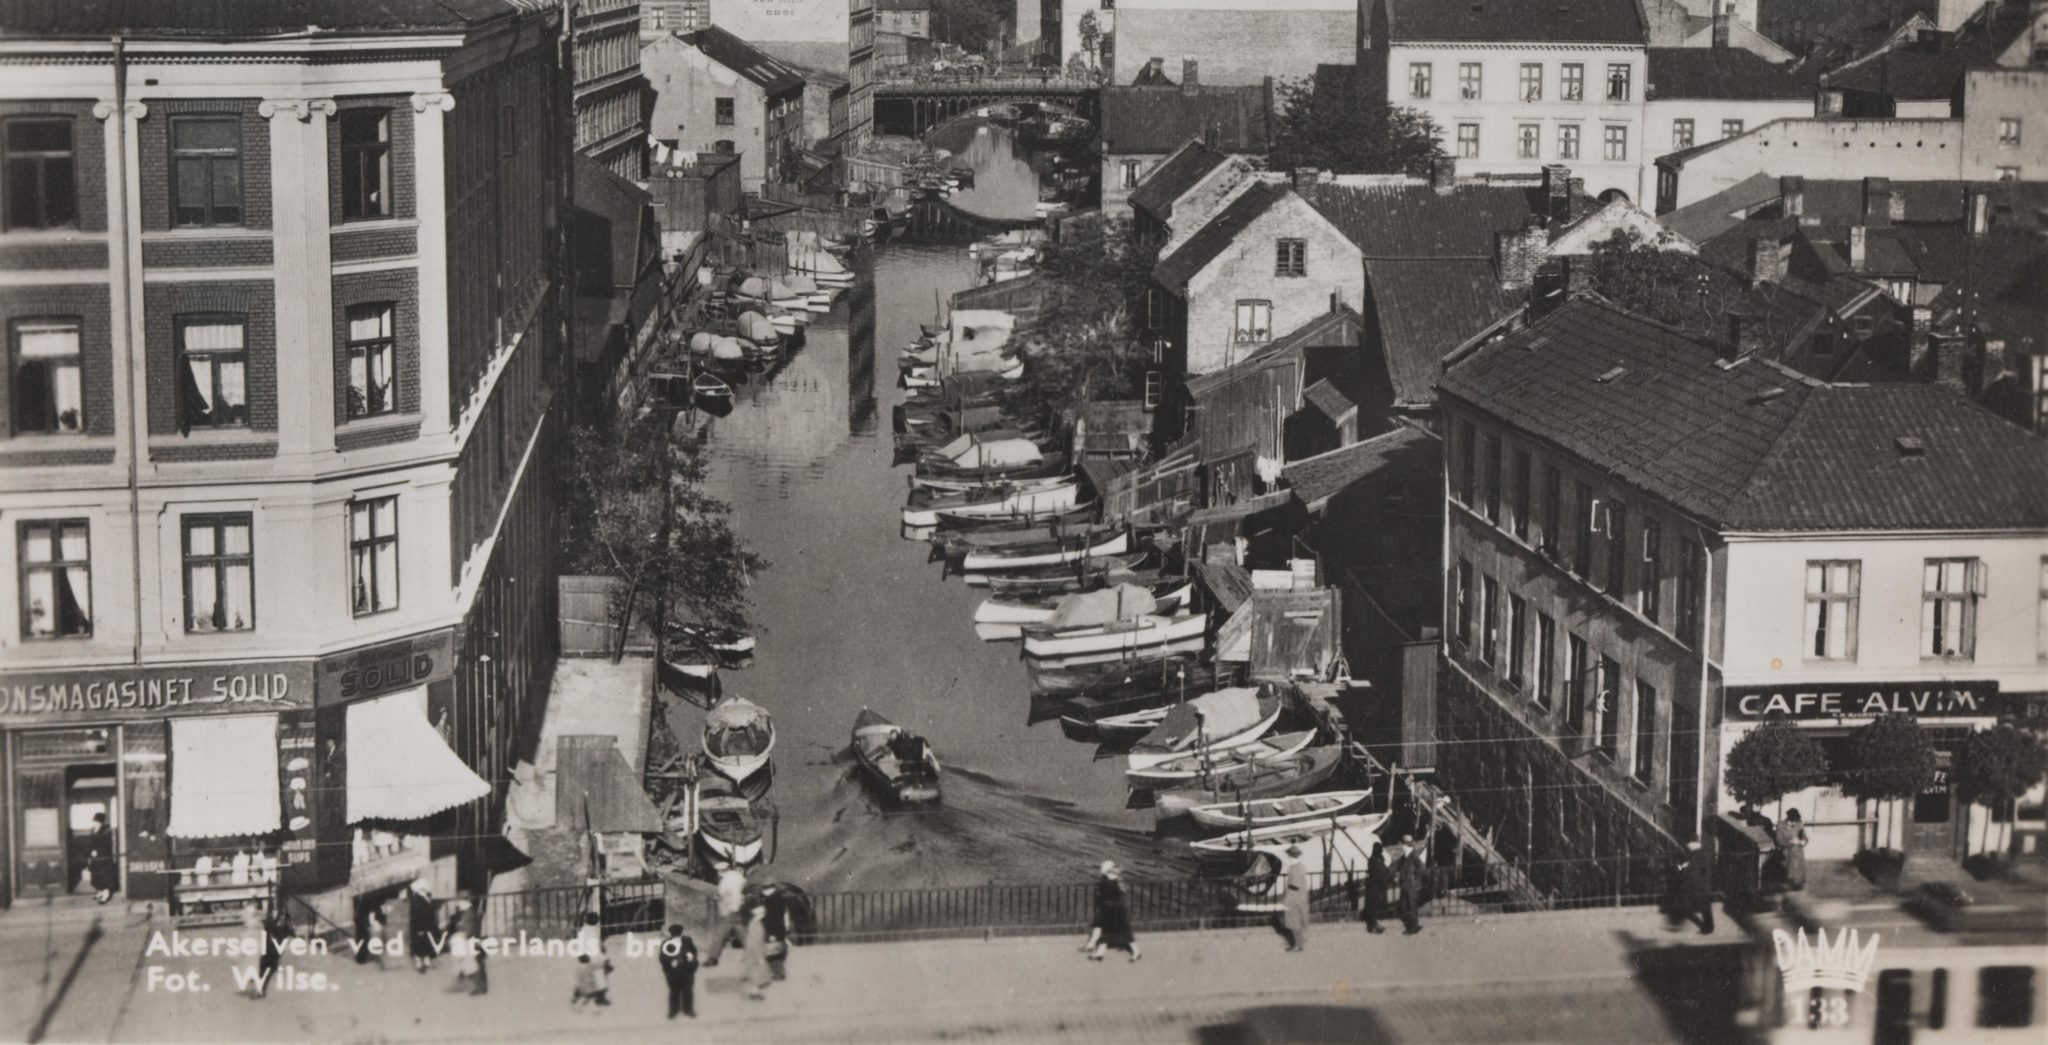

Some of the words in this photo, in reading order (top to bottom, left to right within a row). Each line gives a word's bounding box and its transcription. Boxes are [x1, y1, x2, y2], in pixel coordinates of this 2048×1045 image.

[212, 672, 288, 702] SOLID
[340, 653, 434, 698] SOLID
[1739, 692, 1842, 715] CAFE
